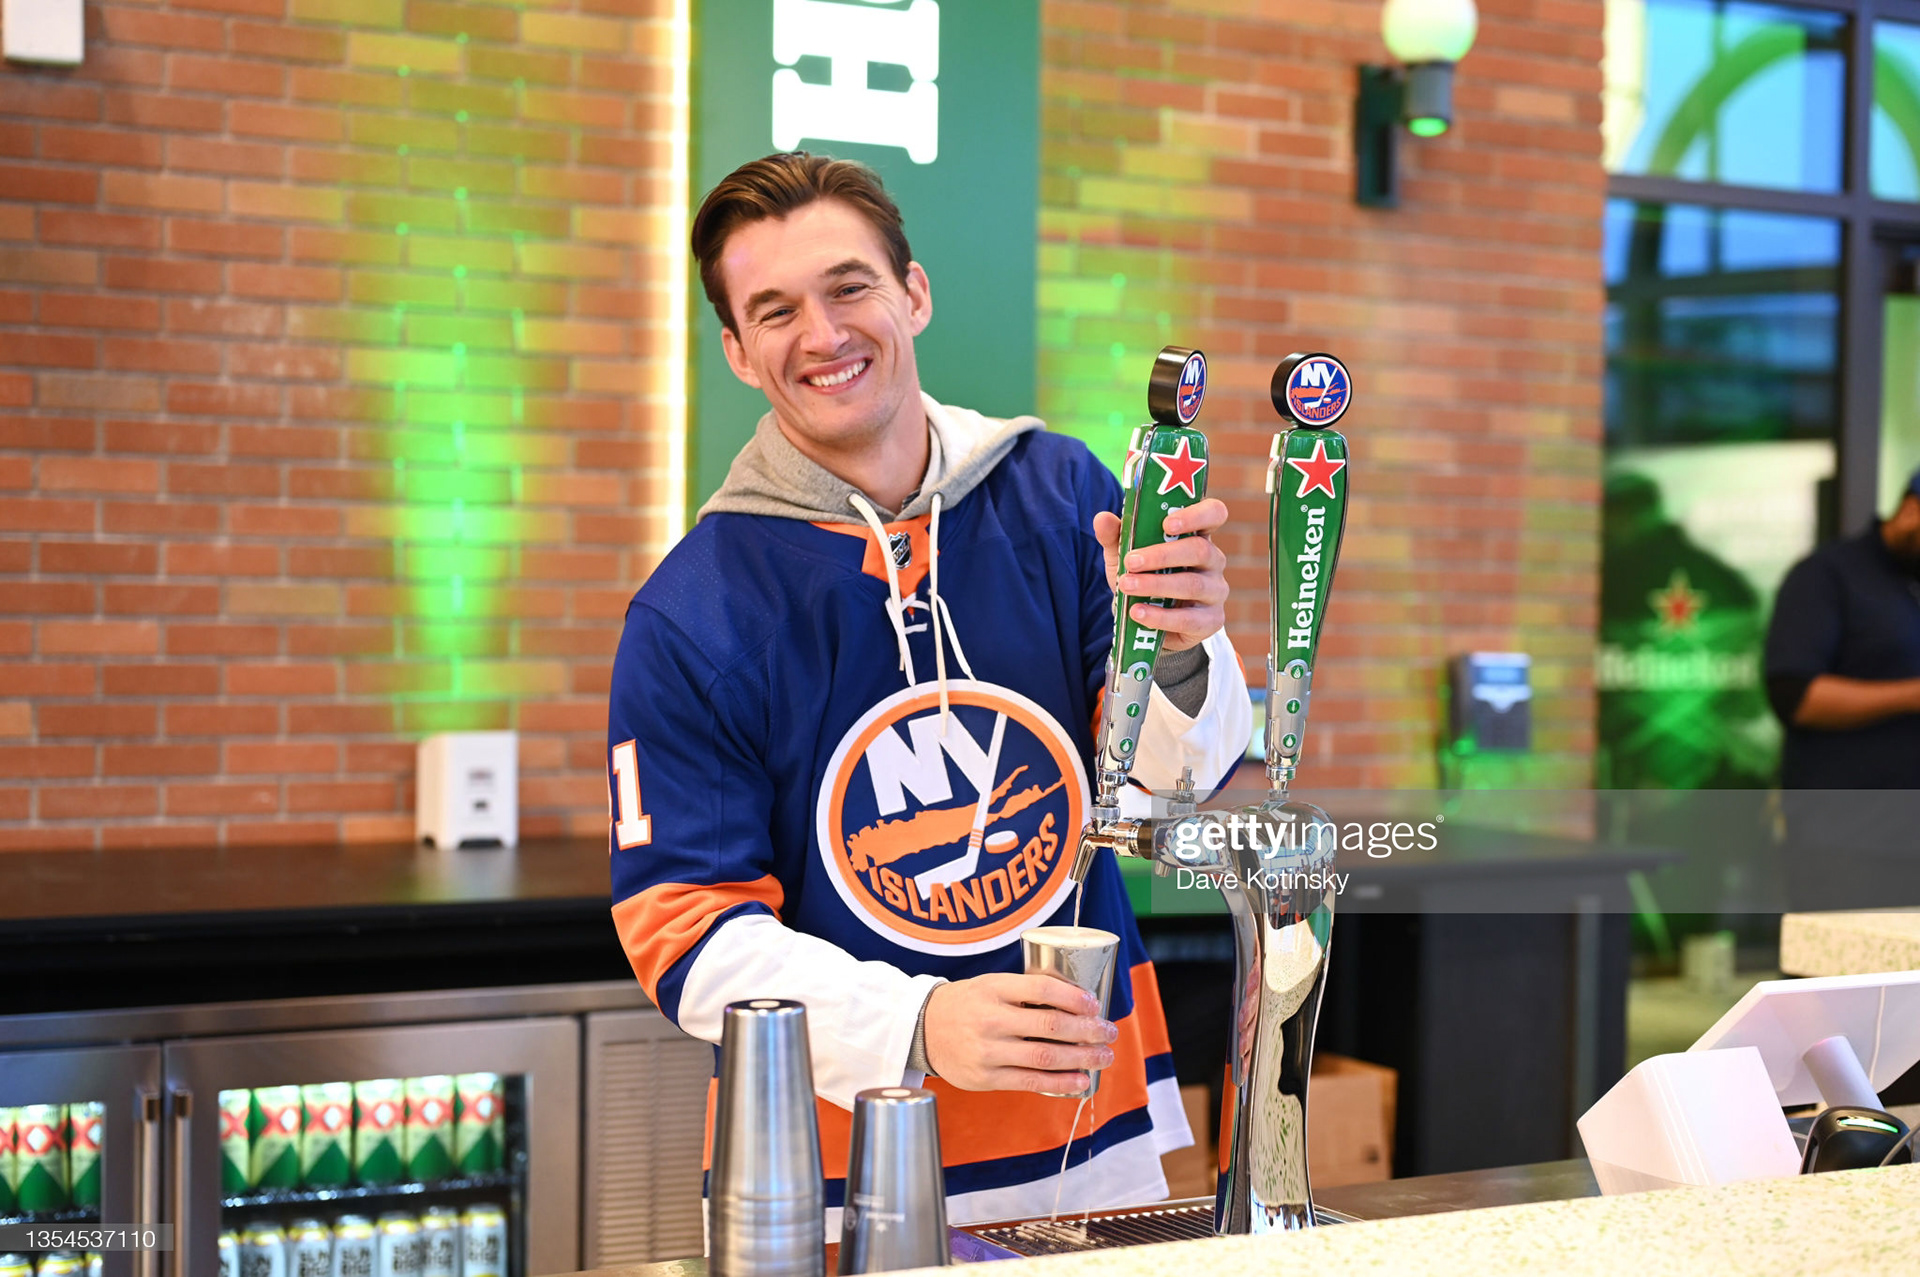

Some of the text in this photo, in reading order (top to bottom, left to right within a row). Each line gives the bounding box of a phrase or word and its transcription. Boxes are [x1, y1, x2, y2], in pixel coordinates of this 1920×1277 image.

[772, 0, 940, 164] H
[1293, 396, 1342, 419] ISLANDERS
[1300, 363, 1338, 388] NY
[1287, 505, 1326, 650] Heineken
[606, 738, 652, 855] 1
[866, 711, 1008, 817] NY
[865, 812, 1059, 924] ISLANDERS
